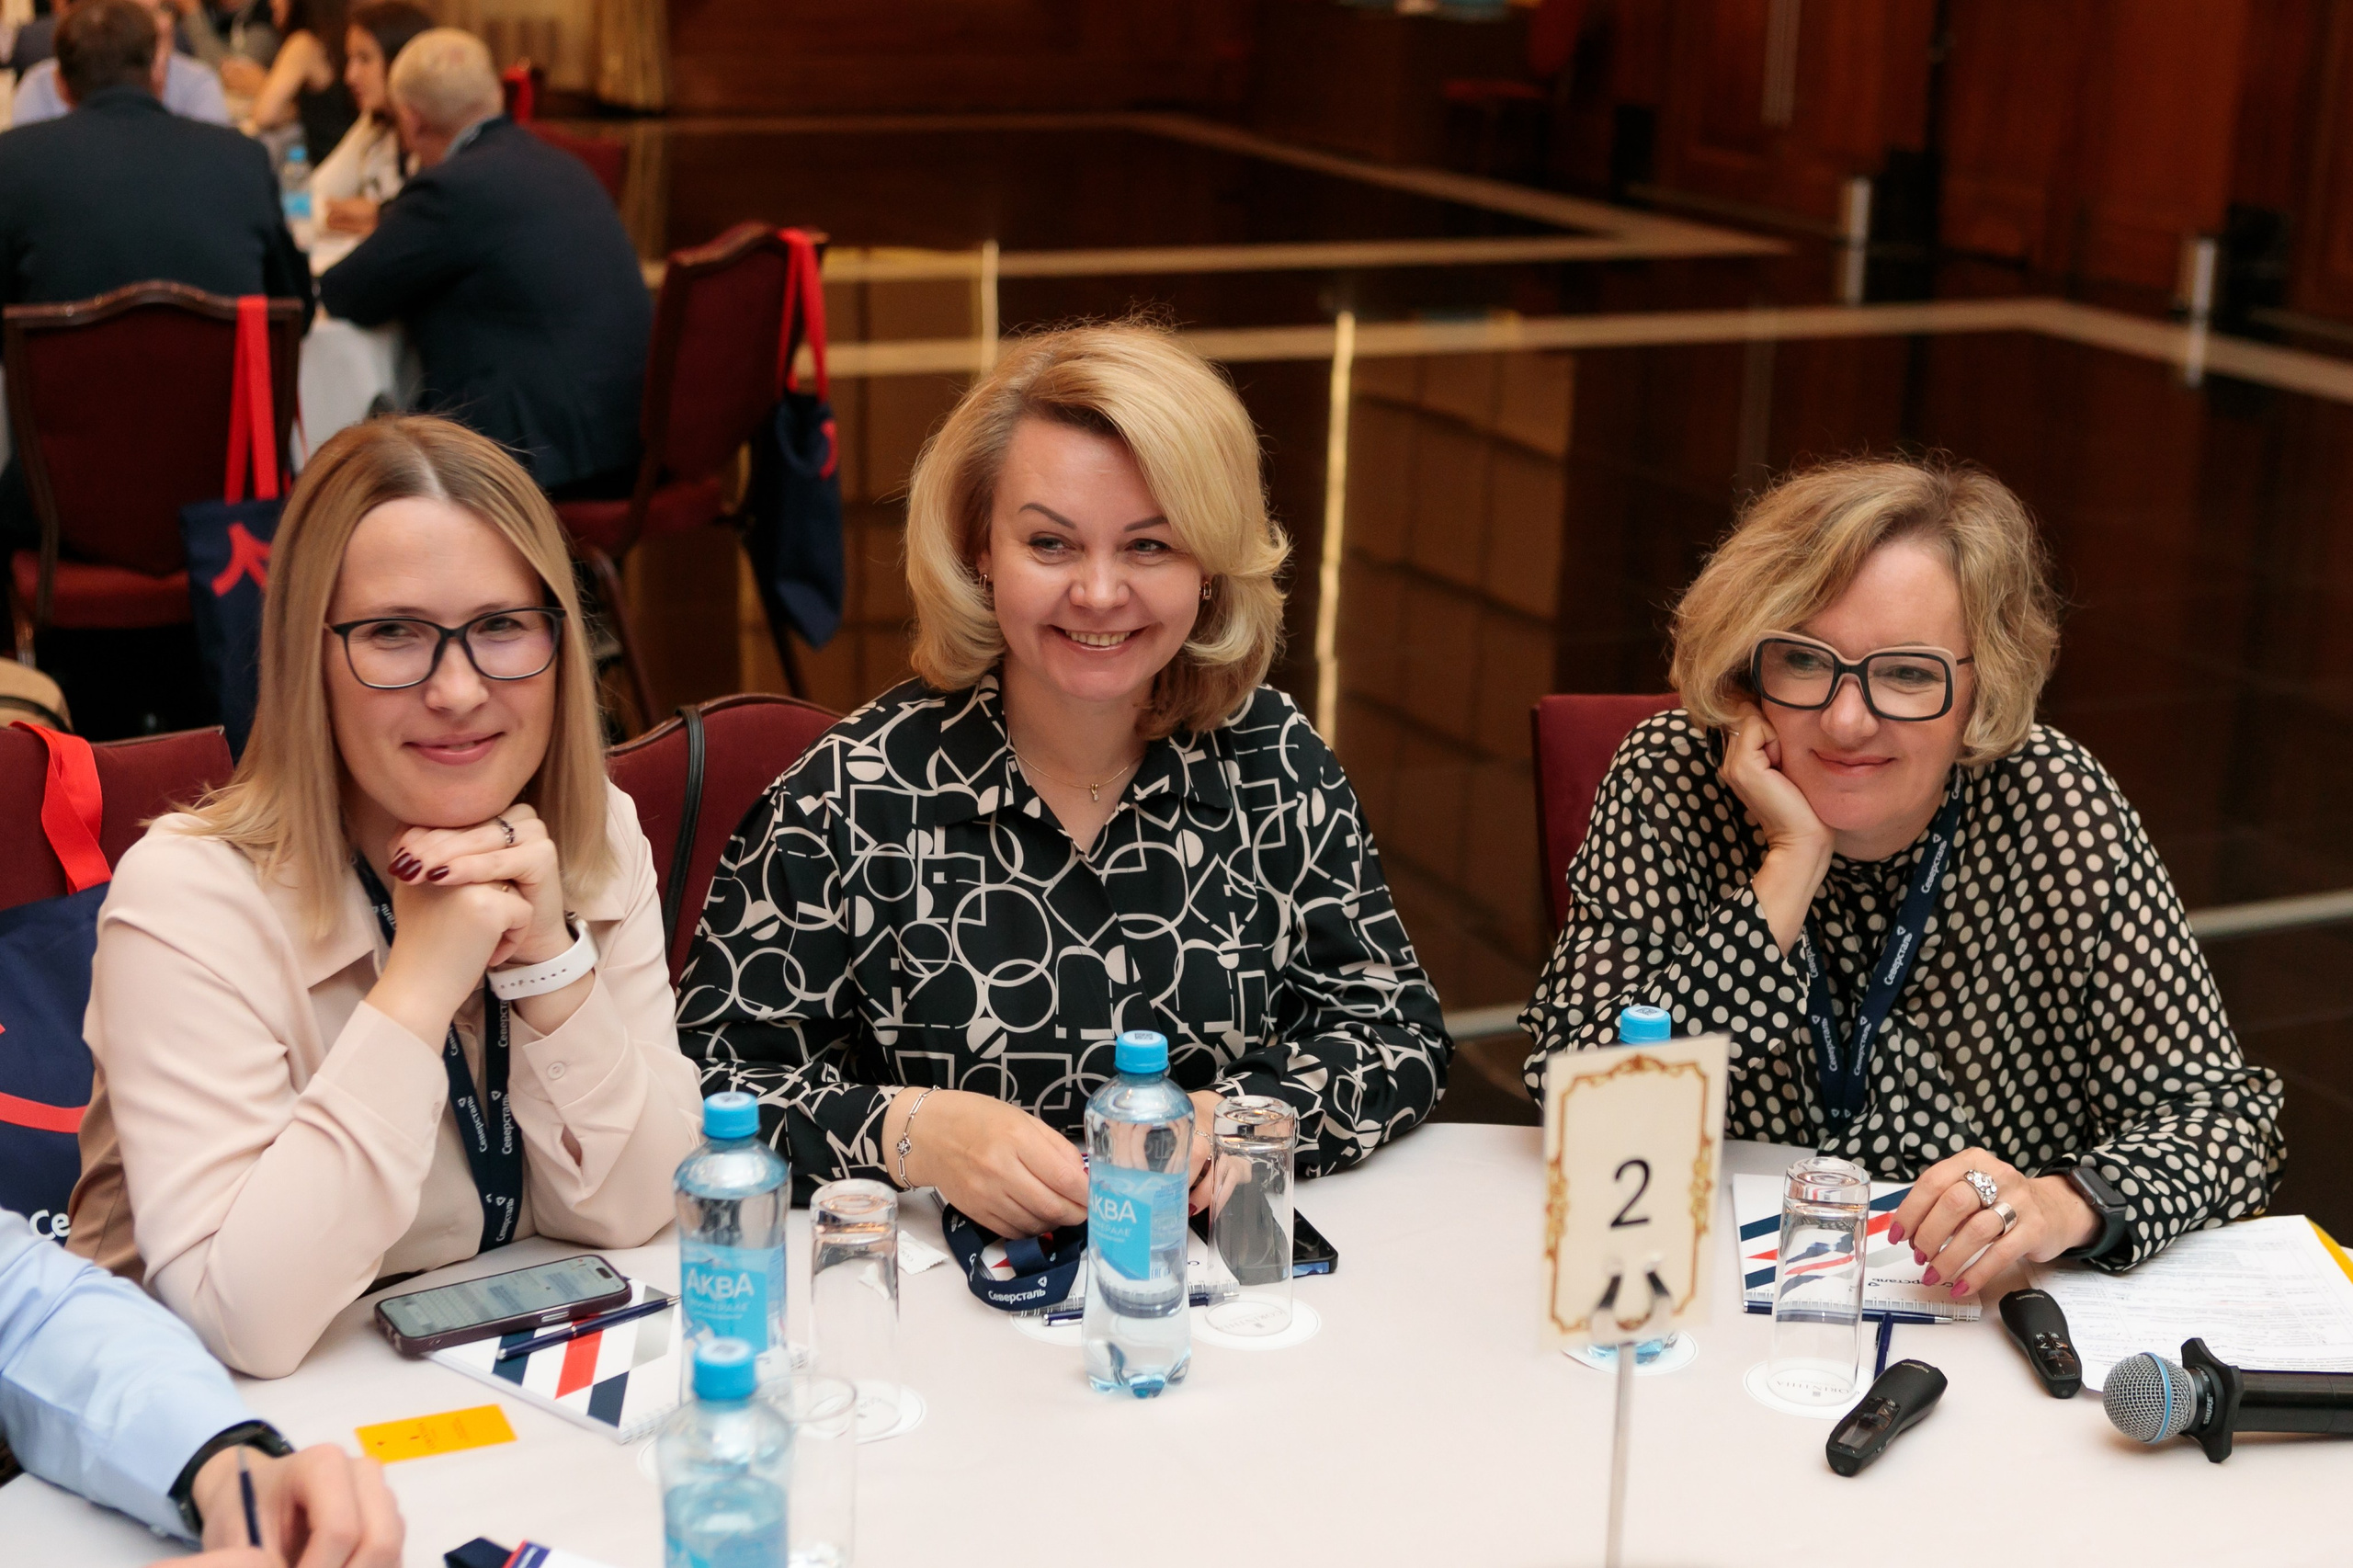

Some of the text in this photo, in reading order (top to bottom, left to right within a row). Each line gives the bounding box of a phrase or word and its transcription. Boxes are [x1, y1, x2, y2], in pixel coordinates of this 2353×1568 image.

[1921, 840, 1948, 893] Северсталь
[1884, 932, 1913, 985] Северсталь
[1822, 1017, 1838, 1072] Северсталь
[1854, 1022, 1872, 1075] Северсталь
[467, 1095, 488, 1153] Северсталь
[496, 1198, 515, 1242] Северсталь
[1610, 1158, 1651, 1229] 2
[686, 1267, 755, 1301] АКВА
[988, 1288, 1046, 1304] Северсталь
